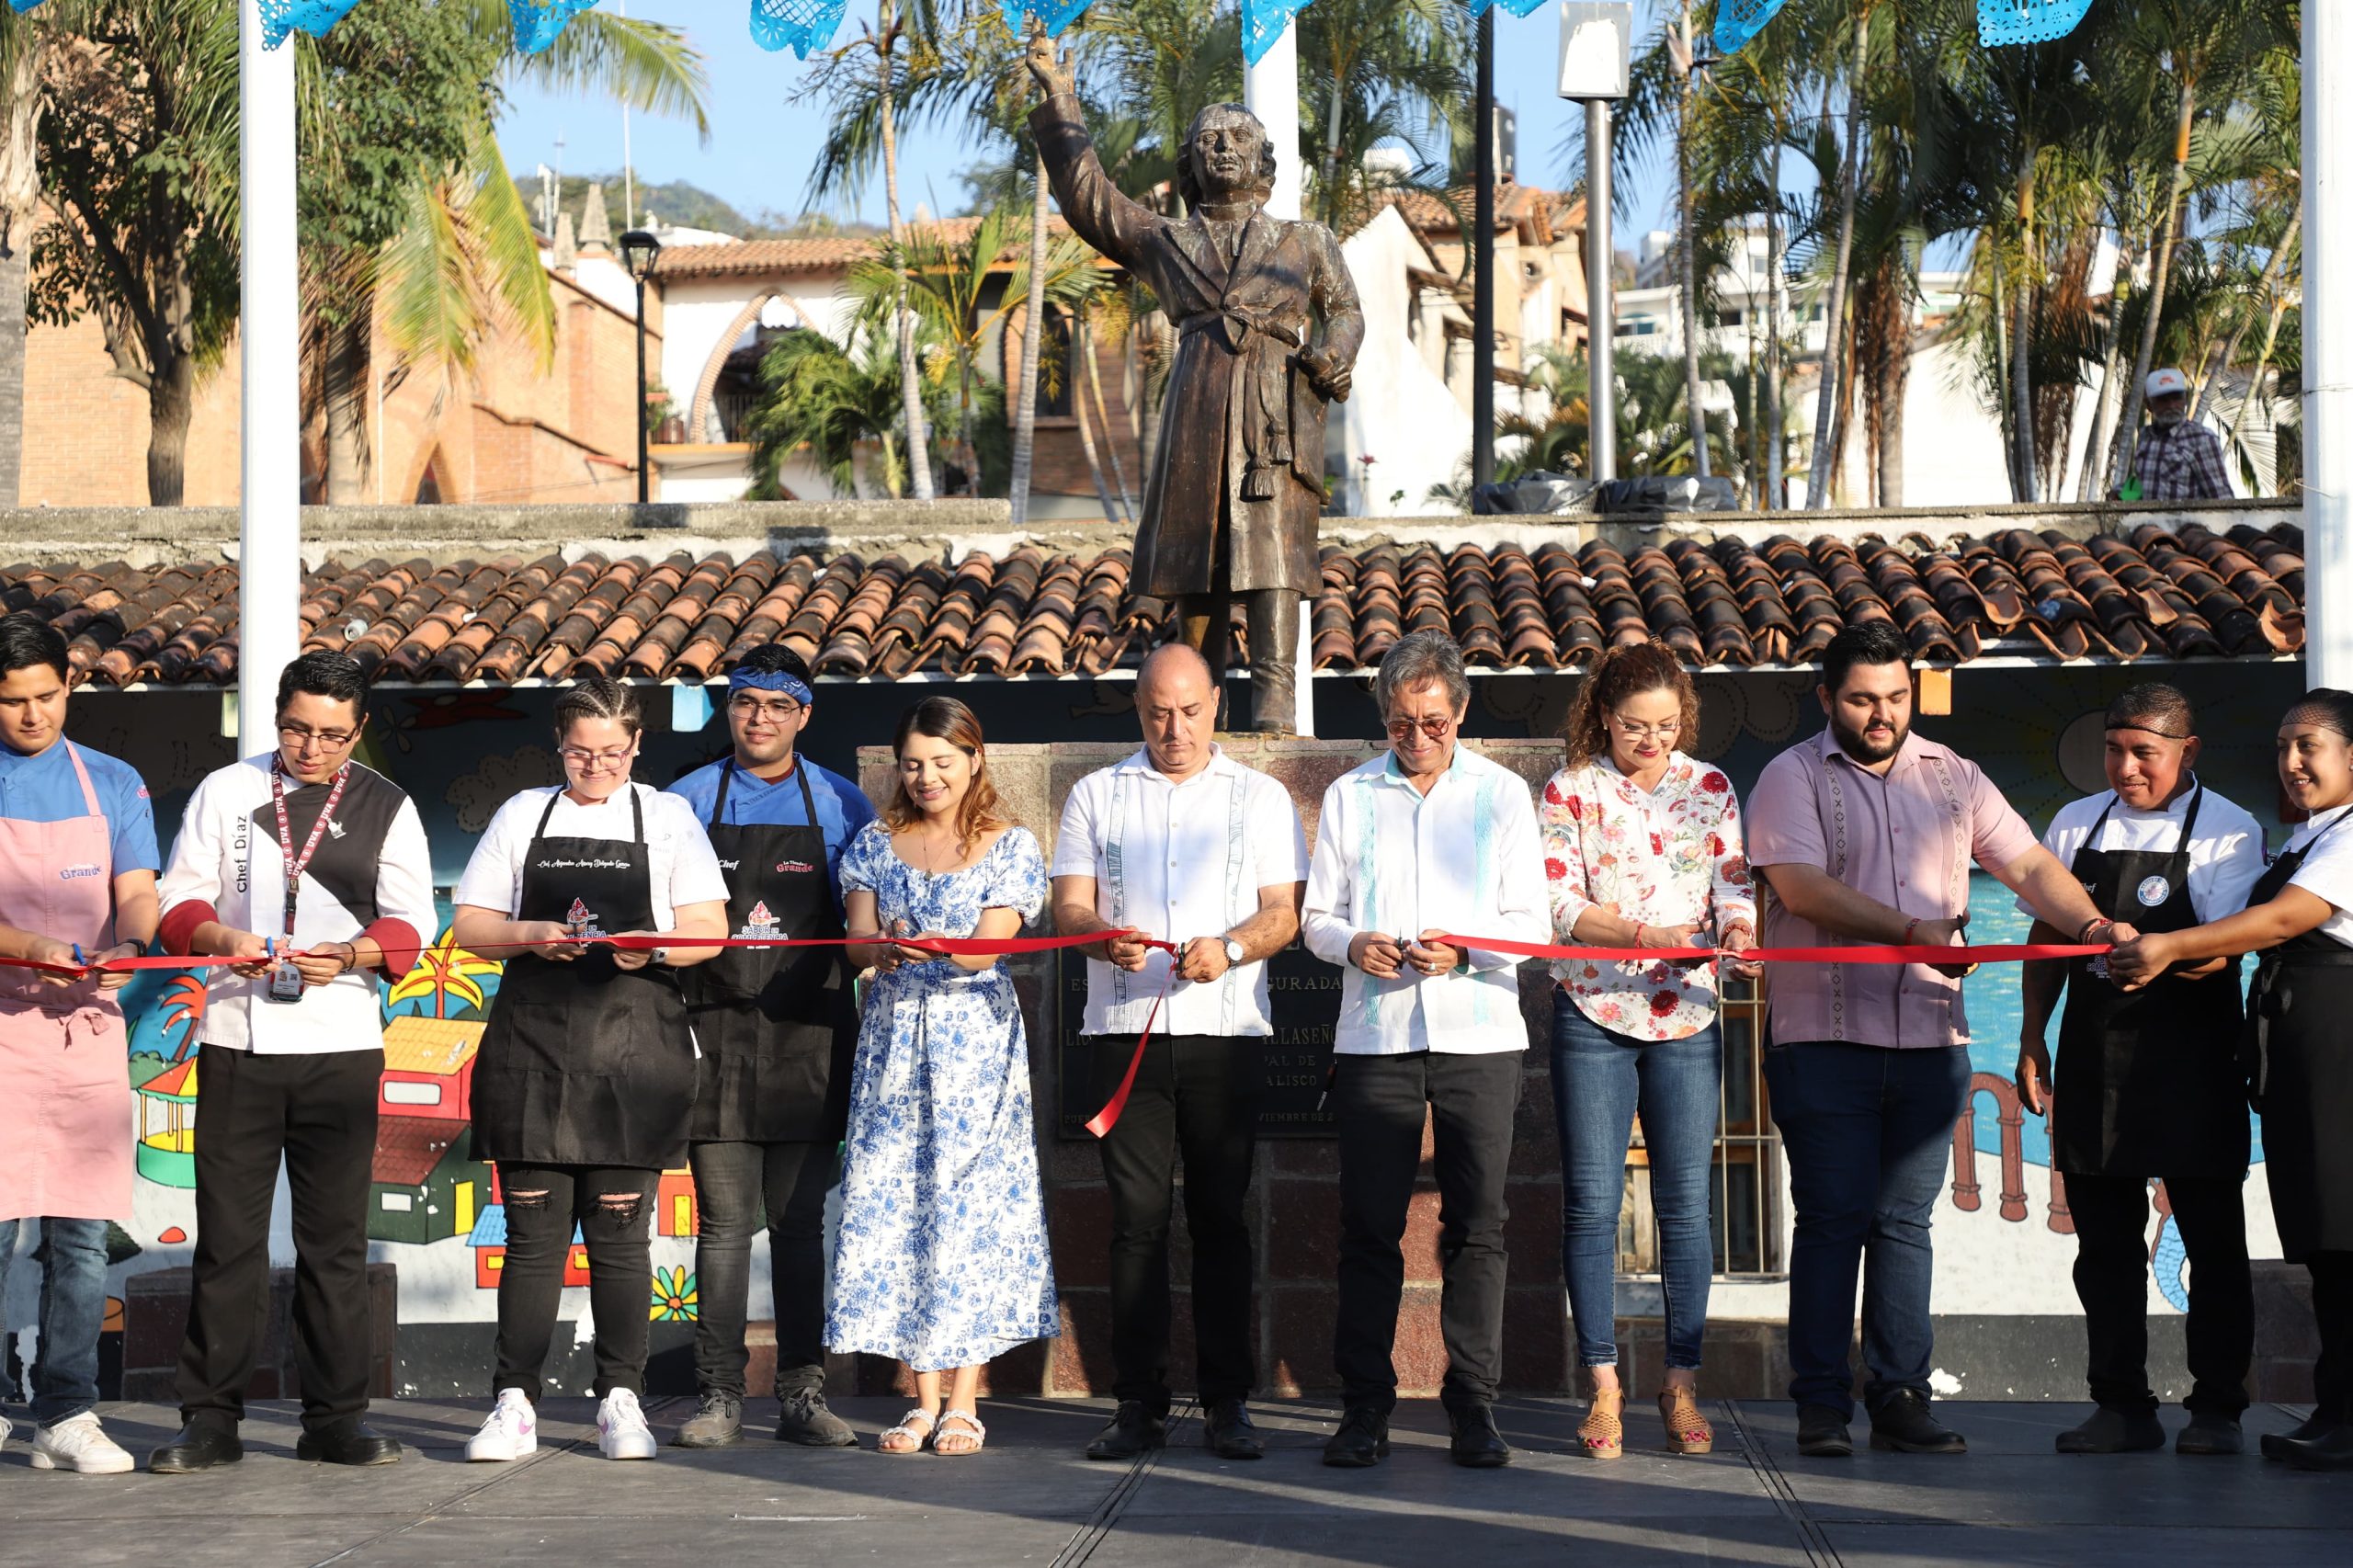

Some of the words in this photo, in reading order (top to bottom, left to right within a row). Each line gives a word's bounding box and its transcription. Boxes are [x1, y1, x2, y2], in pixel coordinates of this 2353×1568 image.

[275, 795, 285, 813] UVA
[307, 830, 322, 847] UVA
[320, 802, 335, 820] UVA
[334, 777, 347, 793] UVA
[232, 815, 247, 849] Díaz
[279, 825, 290, 845] UVA
[718, 859, 740, 870] Chef
[776, 863, 814, 873] Grande
[60, 866, 102, 880] Grande
[234, 858, 247, 893] Chef
[742, 926, 771, 935] SABOR
[1298, 1054, 1317, 1067] DE
[1265, 1074, 1317, 1087] ALISCO
